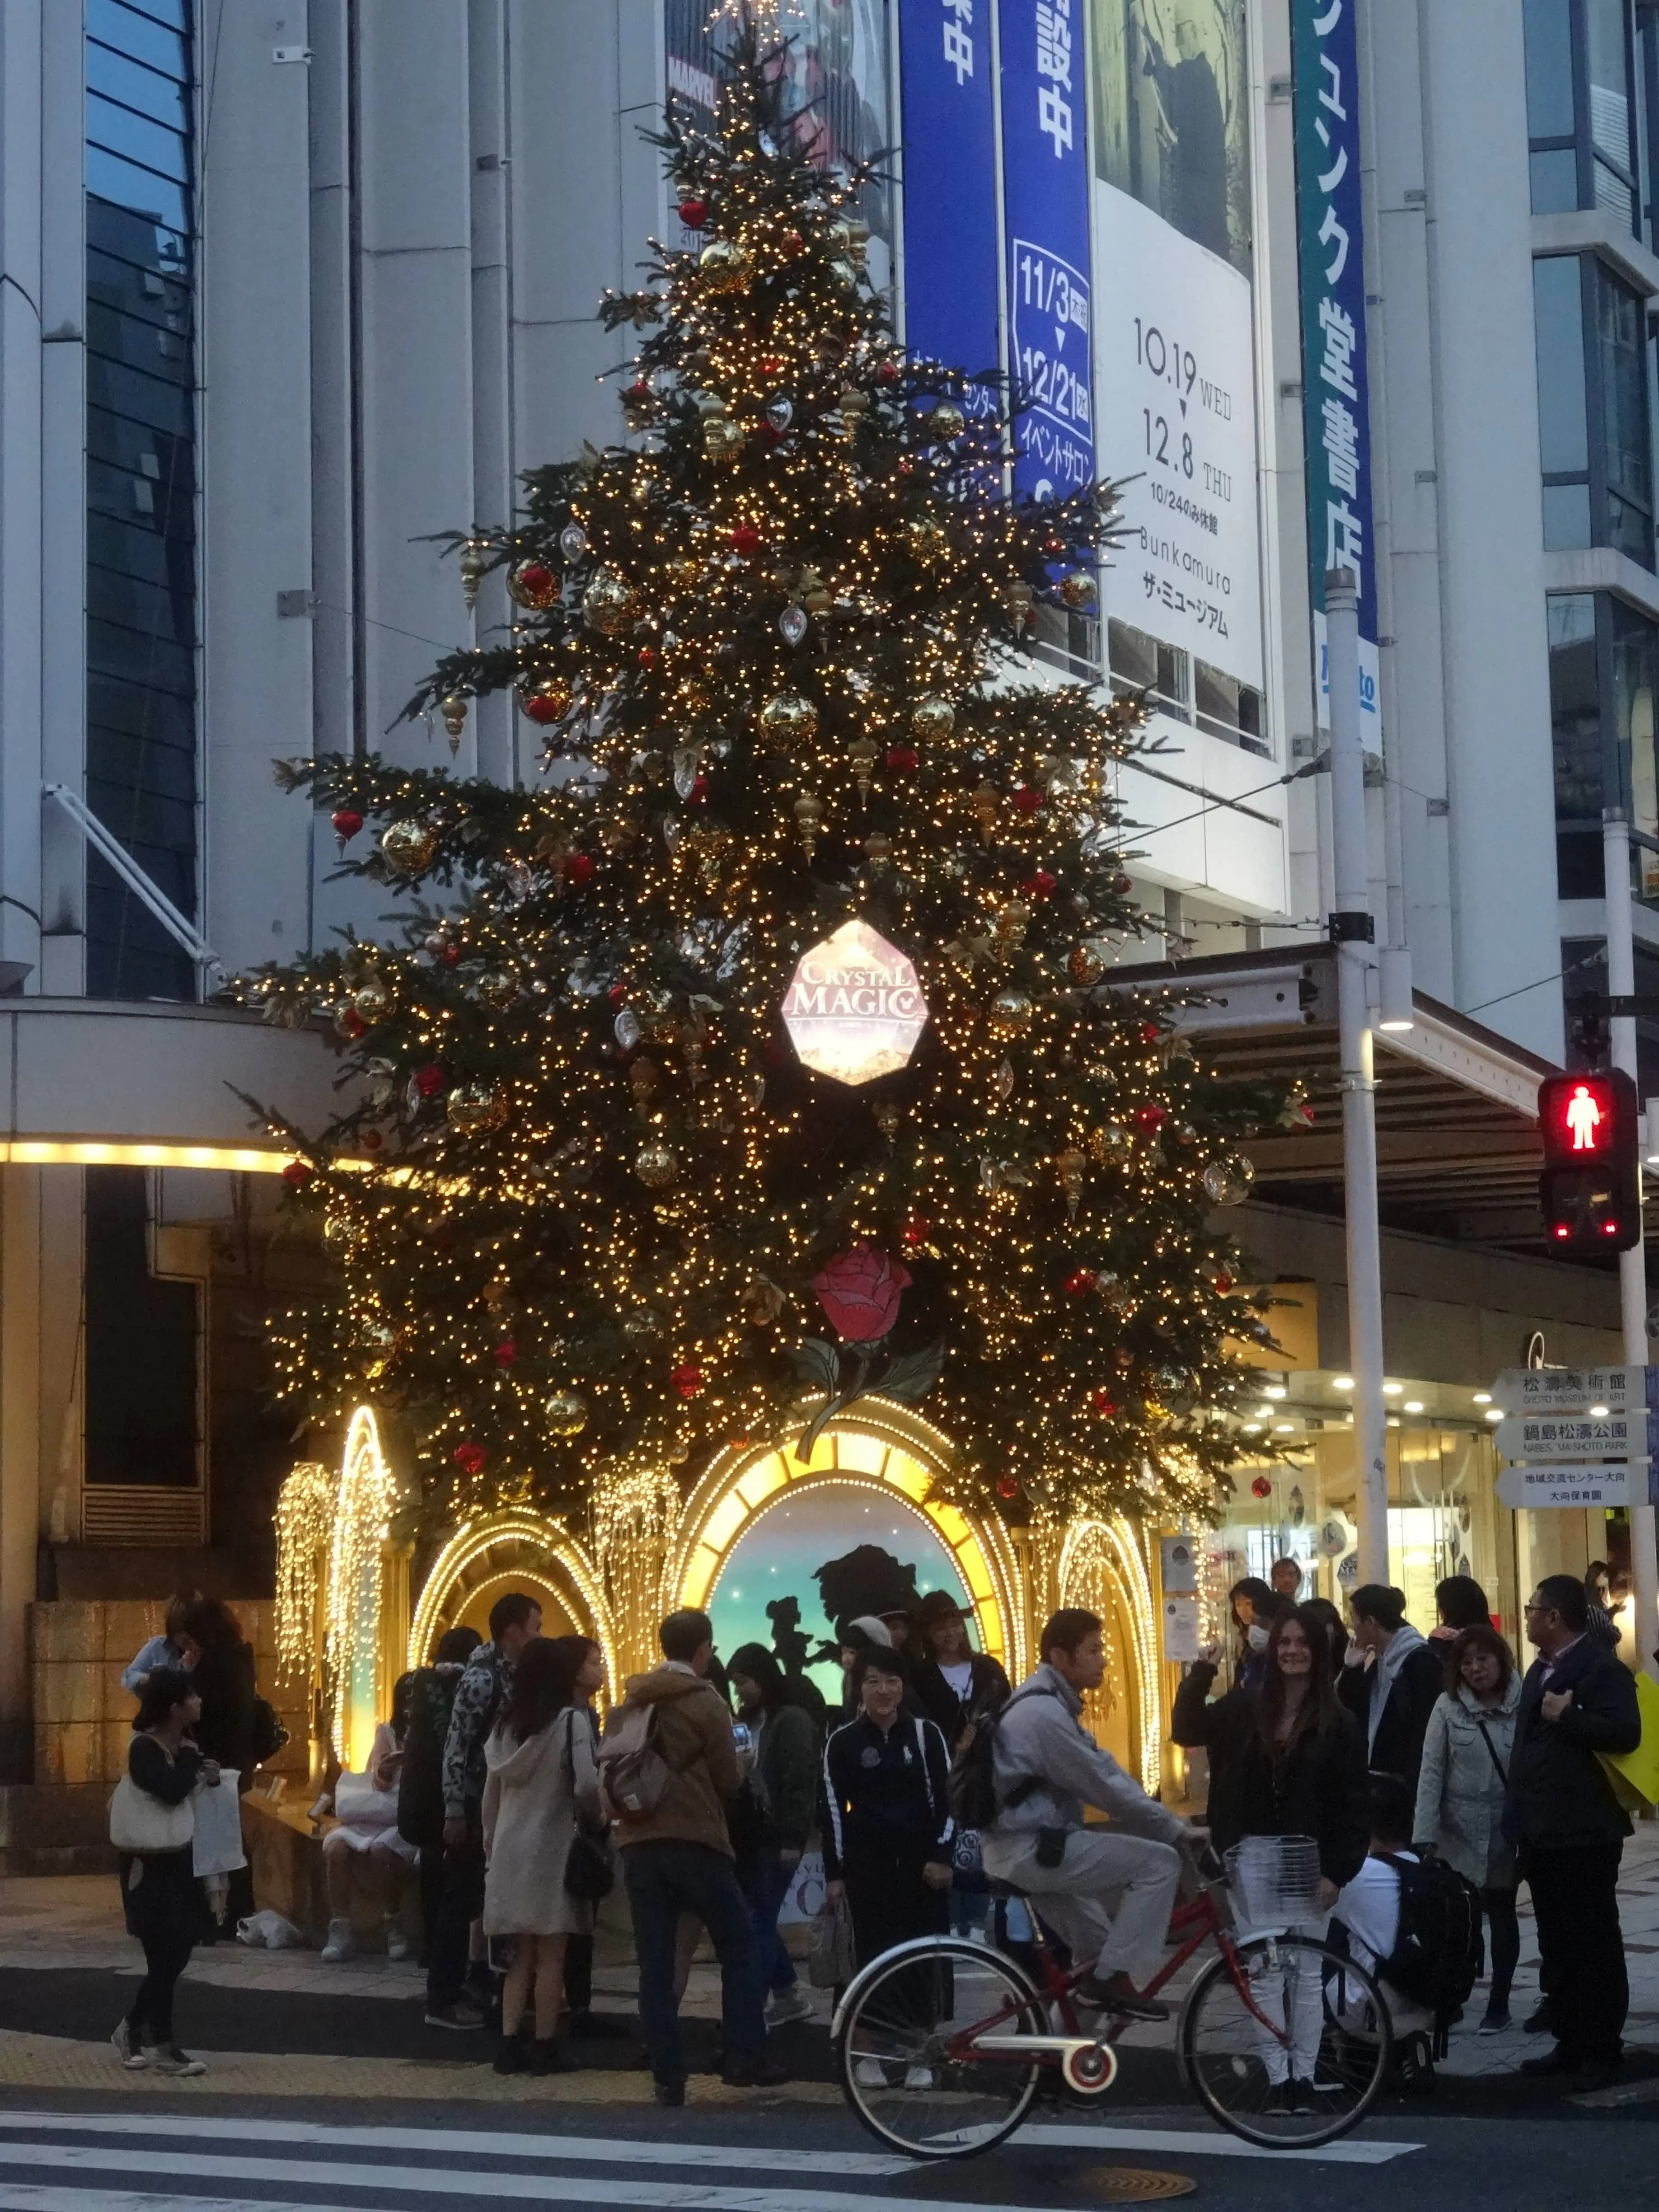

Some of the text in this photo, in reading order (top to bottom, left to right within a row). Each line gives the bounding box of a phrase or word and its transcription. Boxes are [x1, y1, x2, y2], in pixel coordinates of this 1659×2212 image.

[1036, 0, 1072, 159] 設中
[1021, 255, 1069, 323] 11/3
[1021, 347, 1076, 420] 12/21
[1134, 317, 1232, 421] 10.19 WED
[1021, 419, 1094, 486] イベントサロン
[1143, 408, 1232, 502] 12.8 THU
[1151, 481, 1218, 536] 10/24のみ休館
[1140, 525, 1231, 594] Bunkamura
[1143, 570, 1228, 639] ザ・ミュージアム
[791, 983, 919, 1018] MAGIC
[802, 961, 912, 987] CRYSTAL
